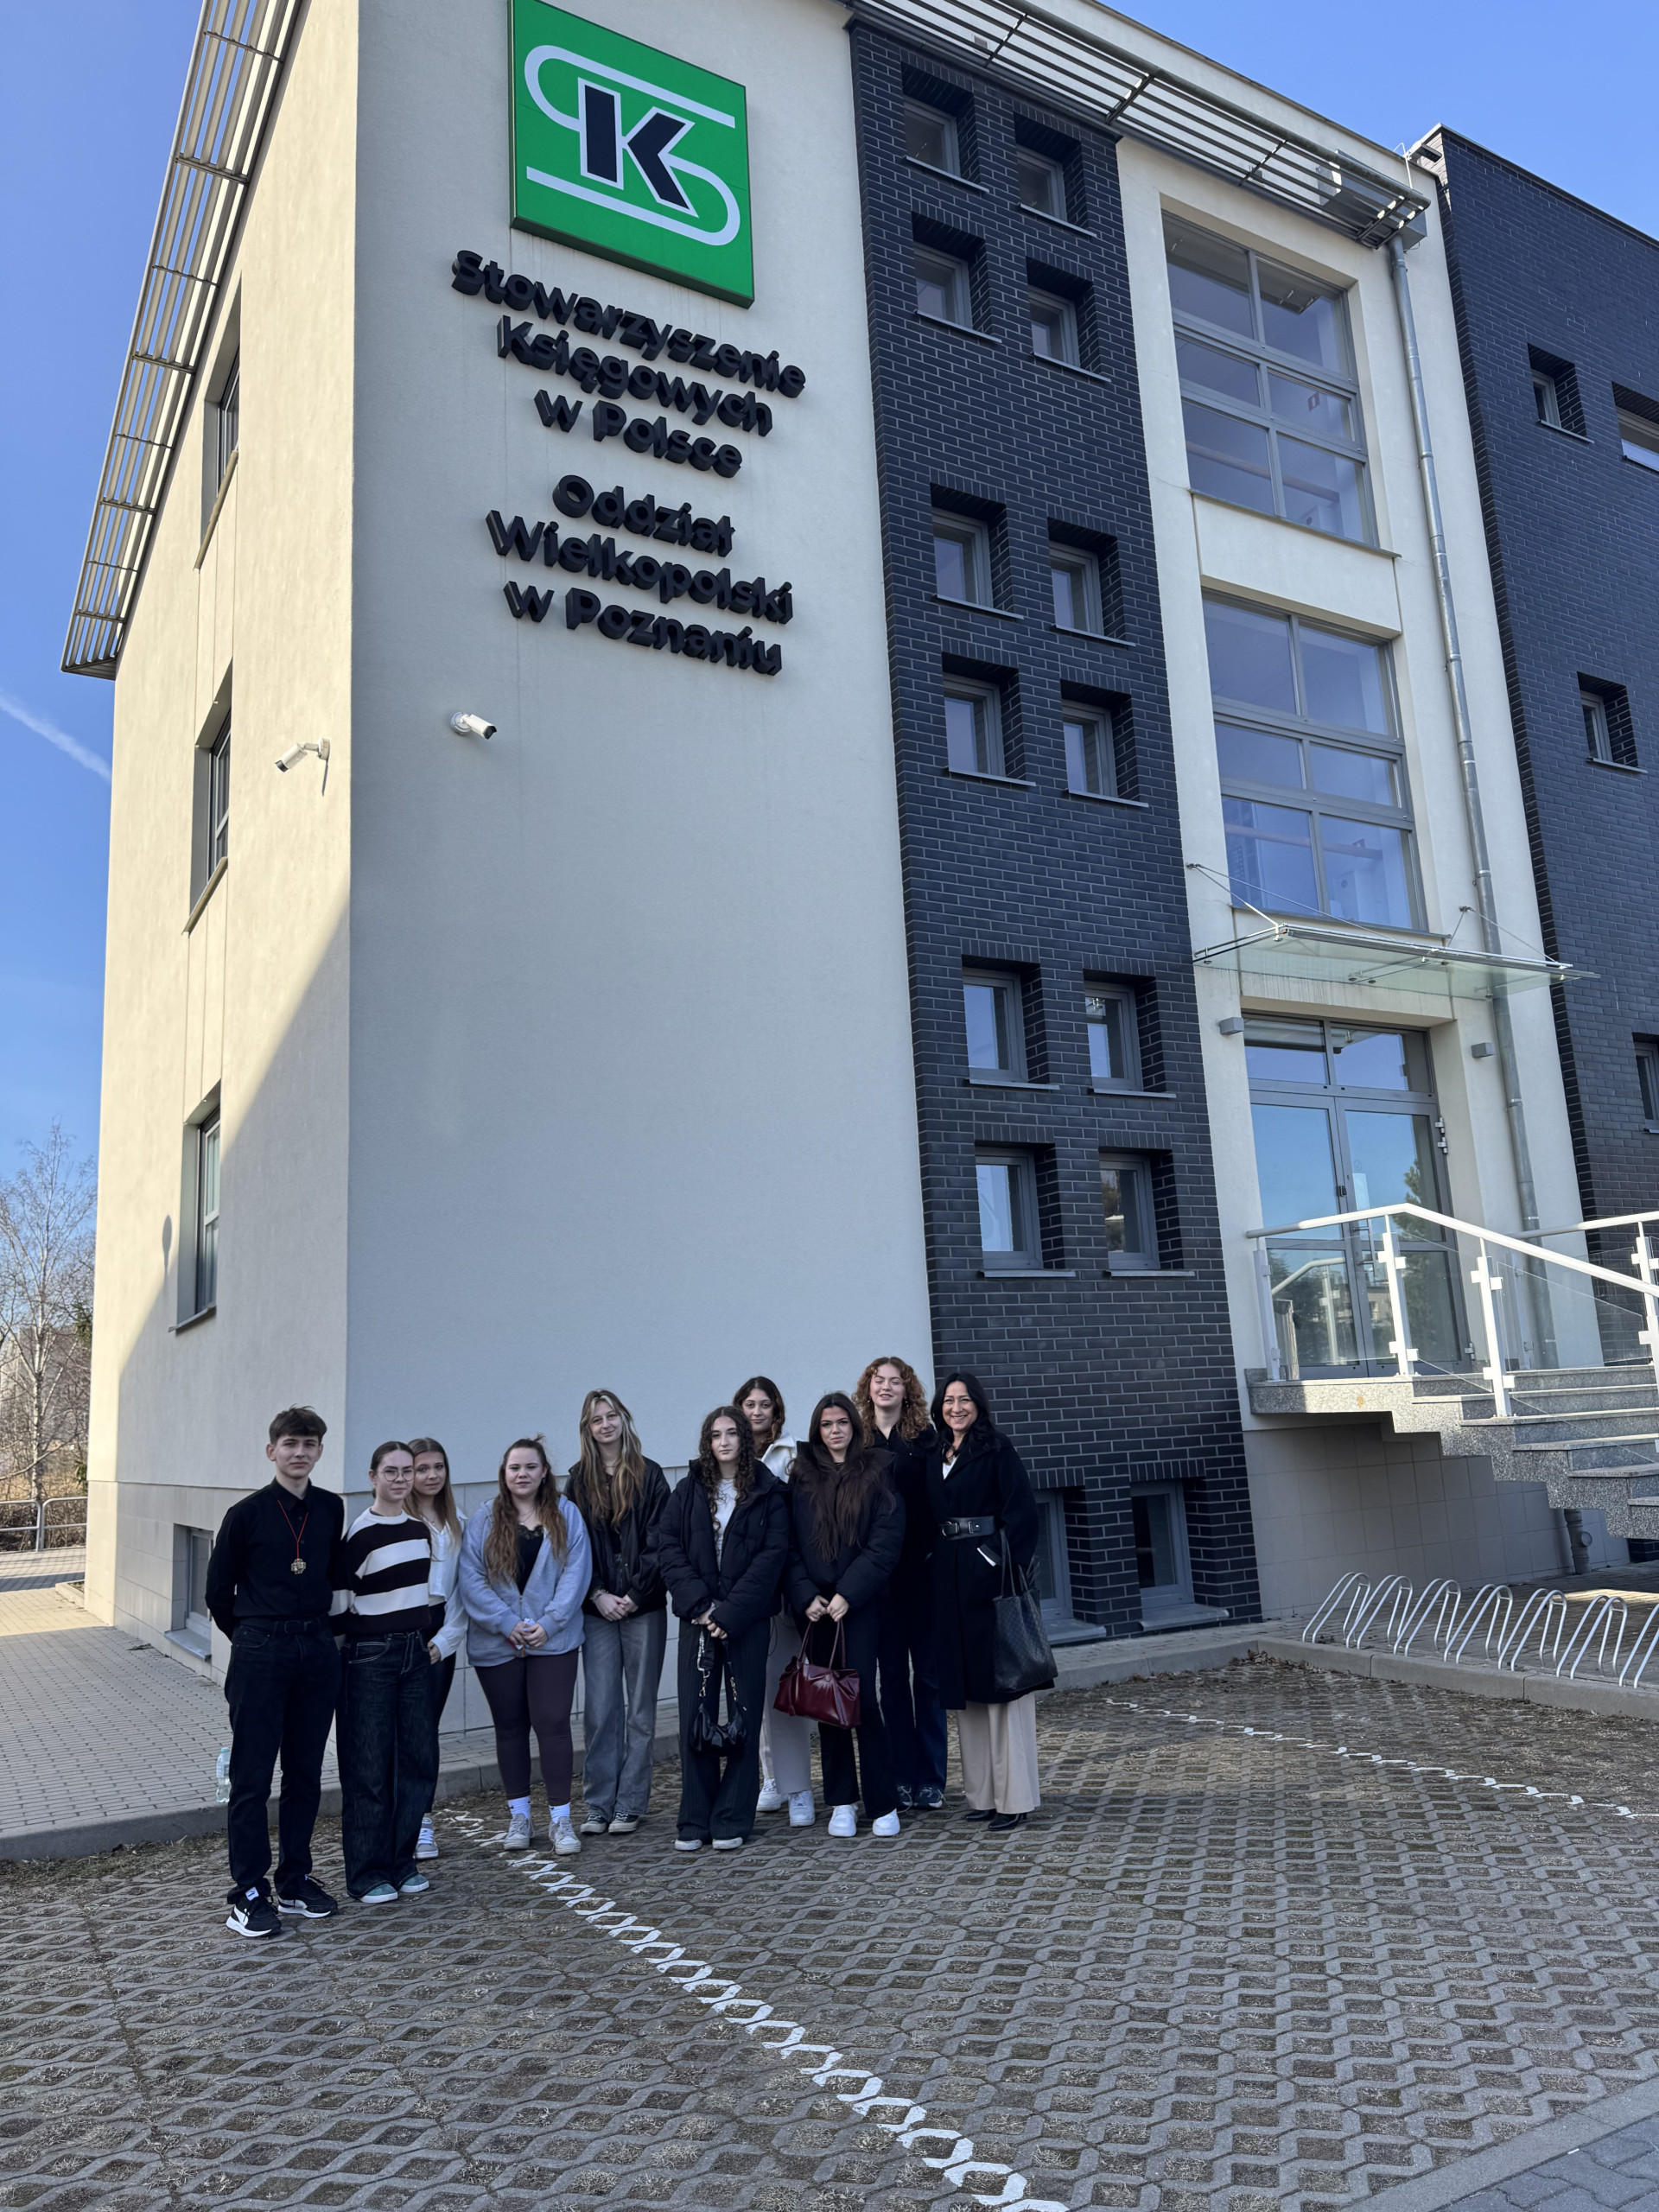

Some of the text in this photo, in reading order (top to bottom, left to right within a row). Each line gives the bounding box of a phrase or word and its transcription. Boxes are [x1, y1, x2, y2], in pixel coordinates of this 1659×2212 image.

[451, 250, 806, 398] Stowarzyszenie
[496, 315, 773, 437] Księgowych
[592, 399, 743, 479] Polsce
[485, 509, 794, 625] Wielkopolski
[551, 474, 736, 557] Oddział
[565, 587, 783, 677] Poznaniu
